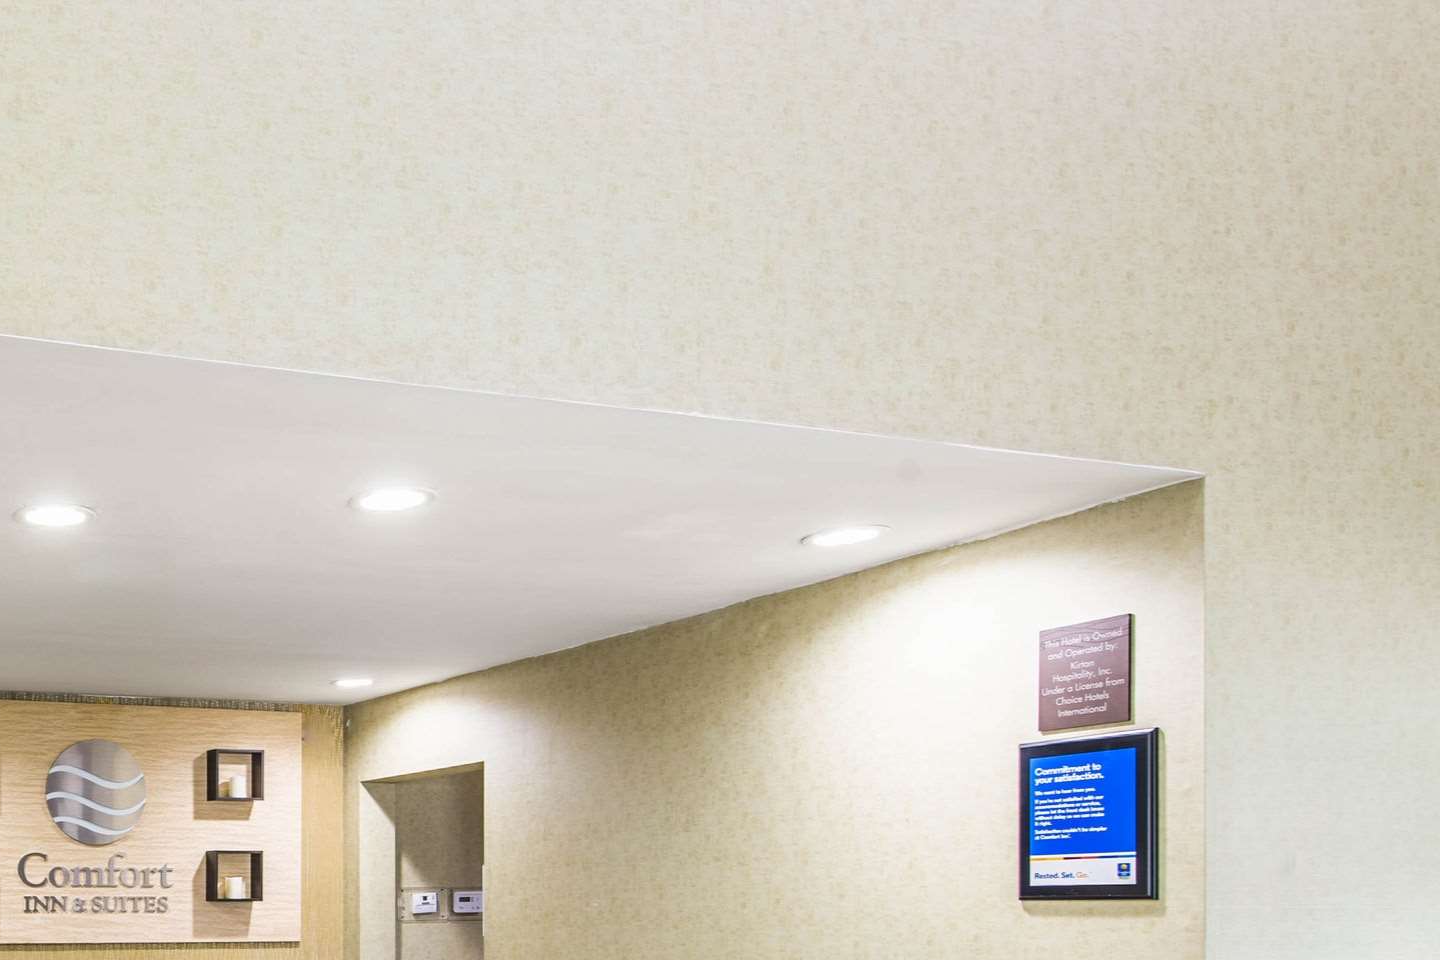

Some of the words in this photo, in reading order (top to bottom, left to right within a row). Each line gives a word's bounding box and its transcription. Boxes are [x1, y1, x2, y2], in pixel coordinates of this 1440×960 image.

[1062, 634, 1081, 645] Hotel
[1092, 628, 1122, 640] Owned
[1048, 650, 1062, 660] and
[1065, 642, 1103, 657] Operated
[1041, 685, 1066, 696] Under
[1075, 681, 1104, 691] License
[1106, 677, 1125, 686] from
[1056, 696, 1082, 705] Choice
[1085, 690, 1109, 701] Hotels
[1057, 702, 1107, 717] International
[1034, 764, 1091, 776] Commitment
[17, 852, 174, 889] Comfort
[24, 896, 68, 913] INN
[71, 897, 87, 913] &
[92, 896, 168, 913] SUITES
